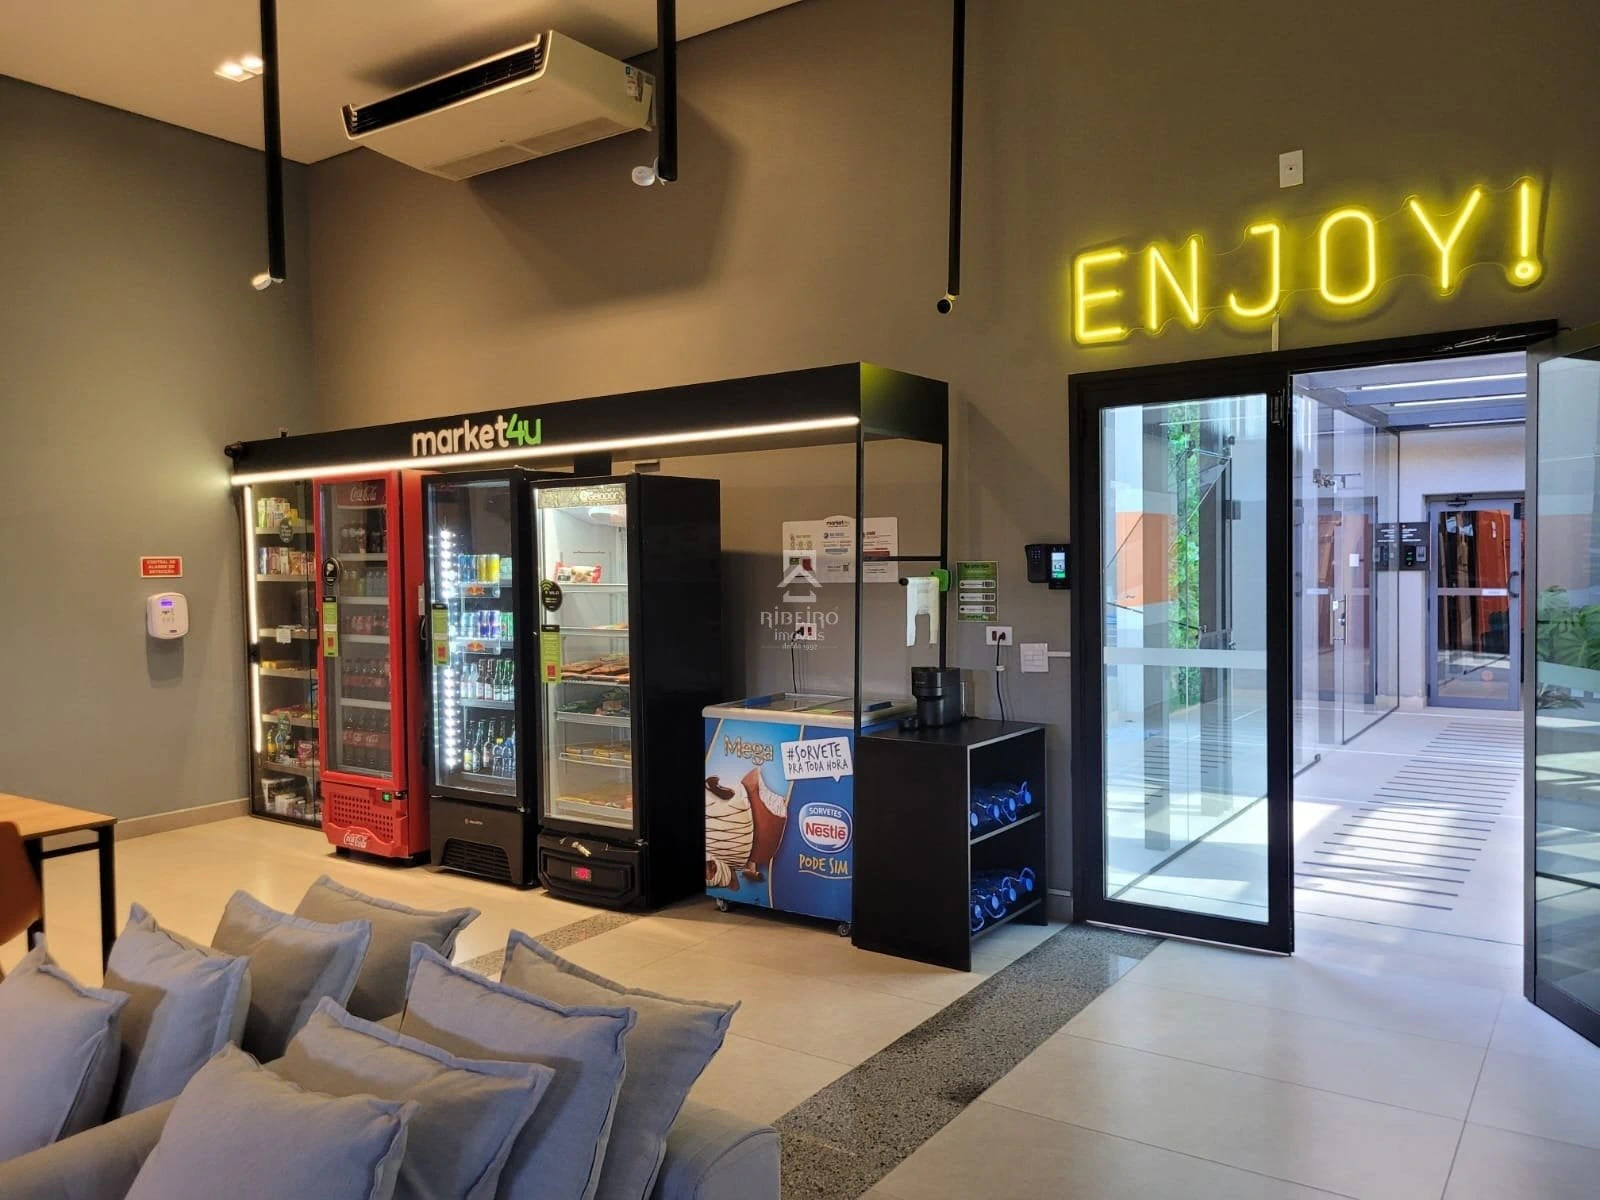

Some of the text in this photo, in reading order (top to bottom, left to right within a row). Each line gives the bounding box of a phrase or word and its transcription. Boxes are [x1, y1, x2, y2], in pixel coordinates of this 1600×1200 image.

[1075, 180, 1540, 340] ENJOY!
[411, 413, 542, 457] market4u
[723, 735, 774, 765] Mega
[786, 742, 842, 763] #SORVETE
[788, 759, 849, 775] PRA TODA HORA
[808, 808, 842, 819] SORVETES
[799, 854, 849, 876] PODE SIM
